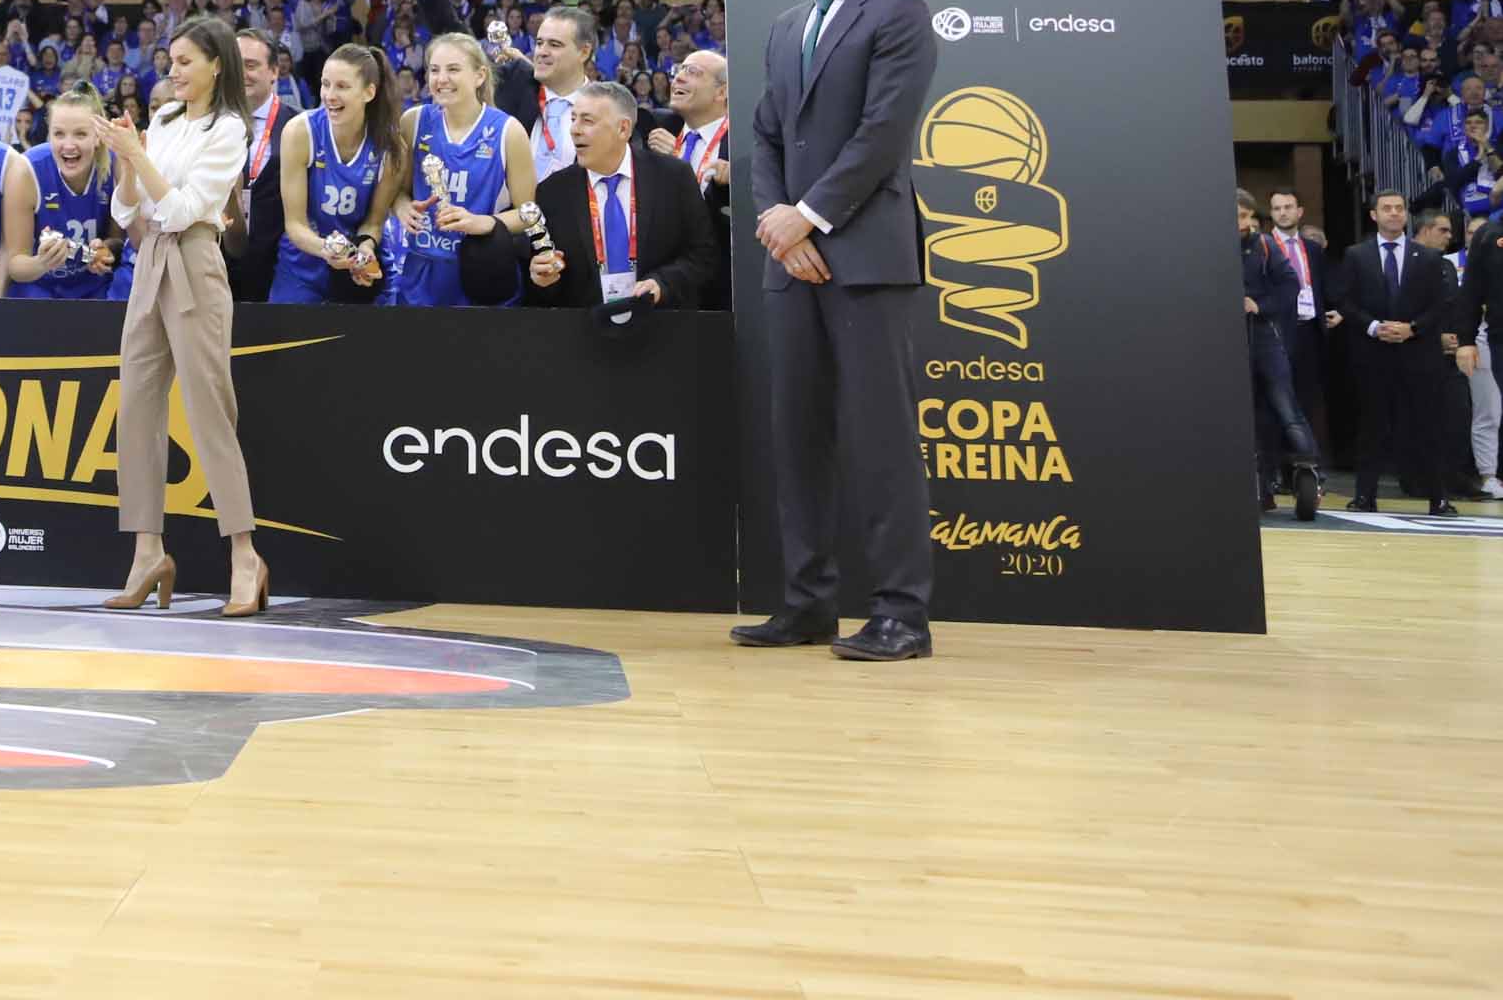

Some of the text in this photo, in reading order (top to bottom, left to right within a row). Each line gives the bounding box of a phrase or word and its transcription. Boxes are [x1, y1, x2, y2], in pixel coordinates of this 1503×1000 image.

[1028, 13, 1116, 33] endesa
[320, 184, 358, 217] 28
[924, 355, 1046, 382] endesa
[917, 397, 1059, 442] COPA
[382, 413, 676, 480] endesa
[935, 442, 1074, 483] REINA
[8, 528, 45, 536] UNIVERSO
[8, 535, 44, 545] MUJER
[928, 509, 1083, 551] alamanca
[1000, 552, 1064, 577] 2020
